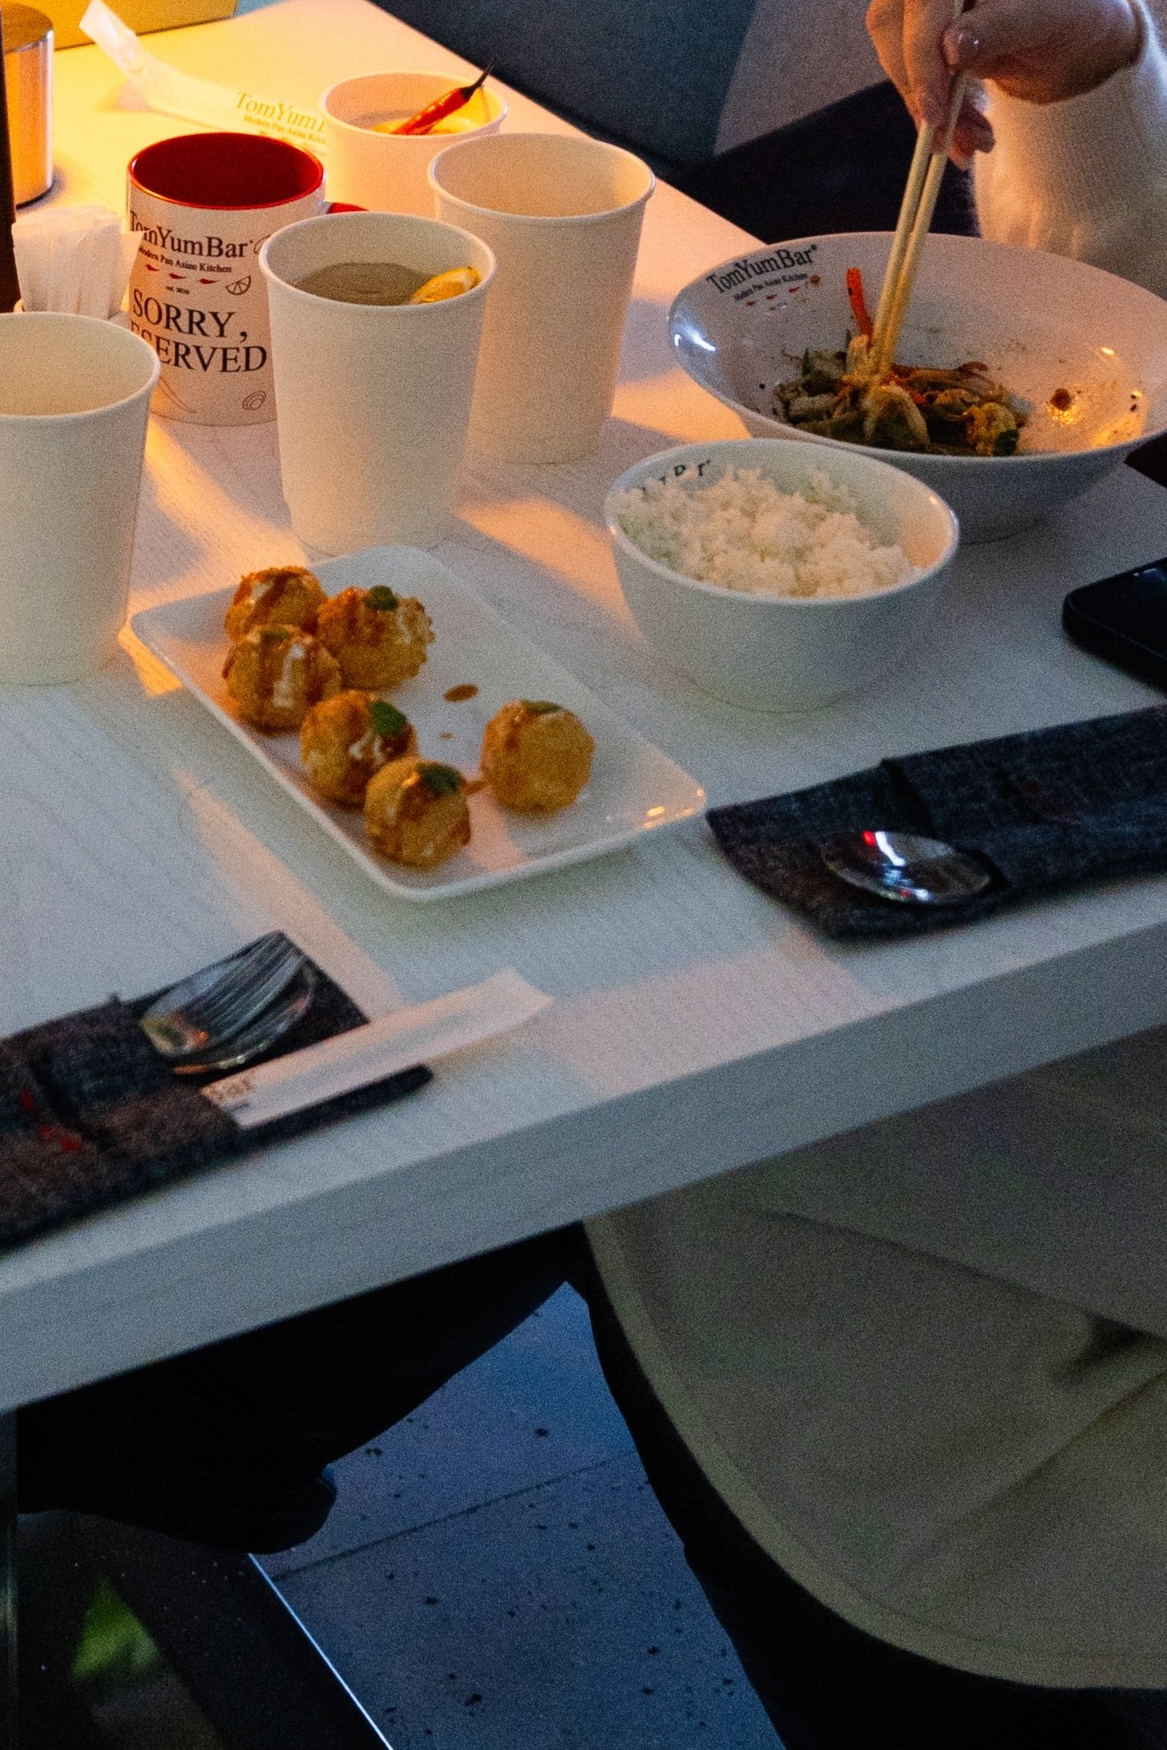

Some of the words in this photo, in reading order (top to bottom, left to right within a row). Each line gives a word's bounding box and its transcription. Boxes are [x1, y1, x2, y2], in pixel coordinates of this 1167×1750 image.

[174, 259, 197, 271] Asian
[199, 262, 232, 274] Kitchen
[706, 247, 814, 293] TomYumBar
[133, 289, 248, 343] SORRY,
